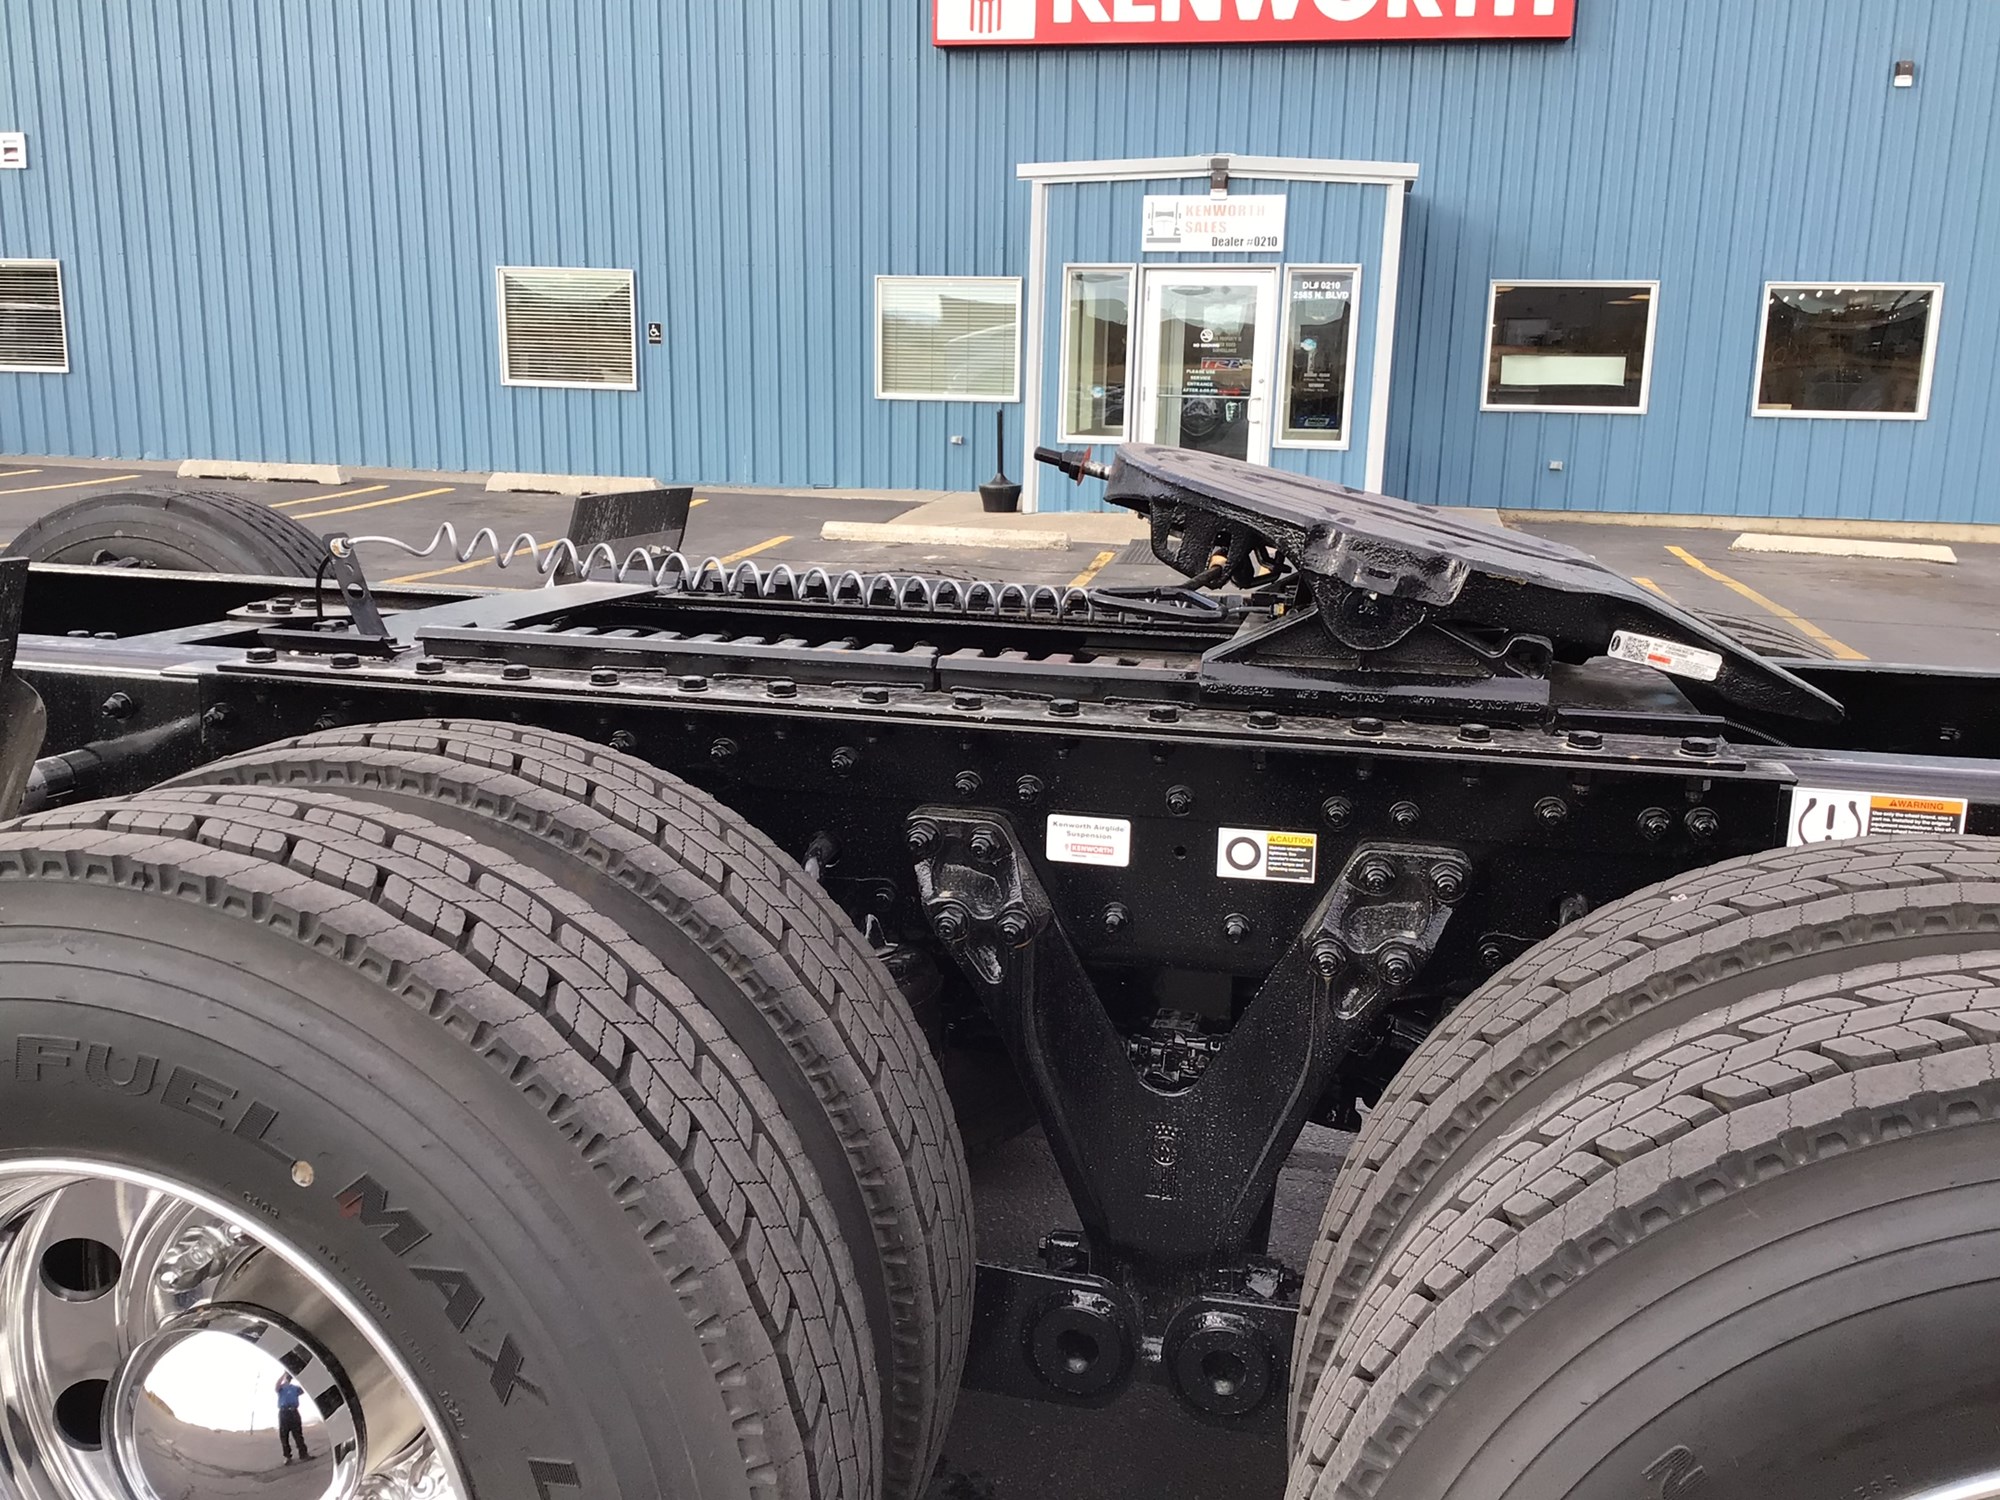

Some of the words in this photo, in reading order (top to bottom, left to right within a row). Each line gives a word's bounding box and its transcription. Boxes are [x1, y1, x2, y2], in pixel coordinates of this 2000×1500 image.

[1185, 204, 1265, 217] KENWORTH
[1185, 221, 1227, 233] SALES
[1212, 236, 1244, 247] Dealer
[1246, 236, 1278, 247] #0210
[1302, 281, 1320, 289] DL#
[1321, 281, 1341, 290] 0210
[1325, 291, 1349, 300] BLVD
[1898, 800, 1944, 810] WARNING
[1053, 821, 1091, 829] Kenworth
[1066, 831, 1112, 839] Suspension
[1276, 836, 1313, 844] CAUTION
[1072, 844, 1113, 854] KENWORTH
[15, 1033, 297, 1164] FUEL
[332, 1170, 550, 1407] MAX
